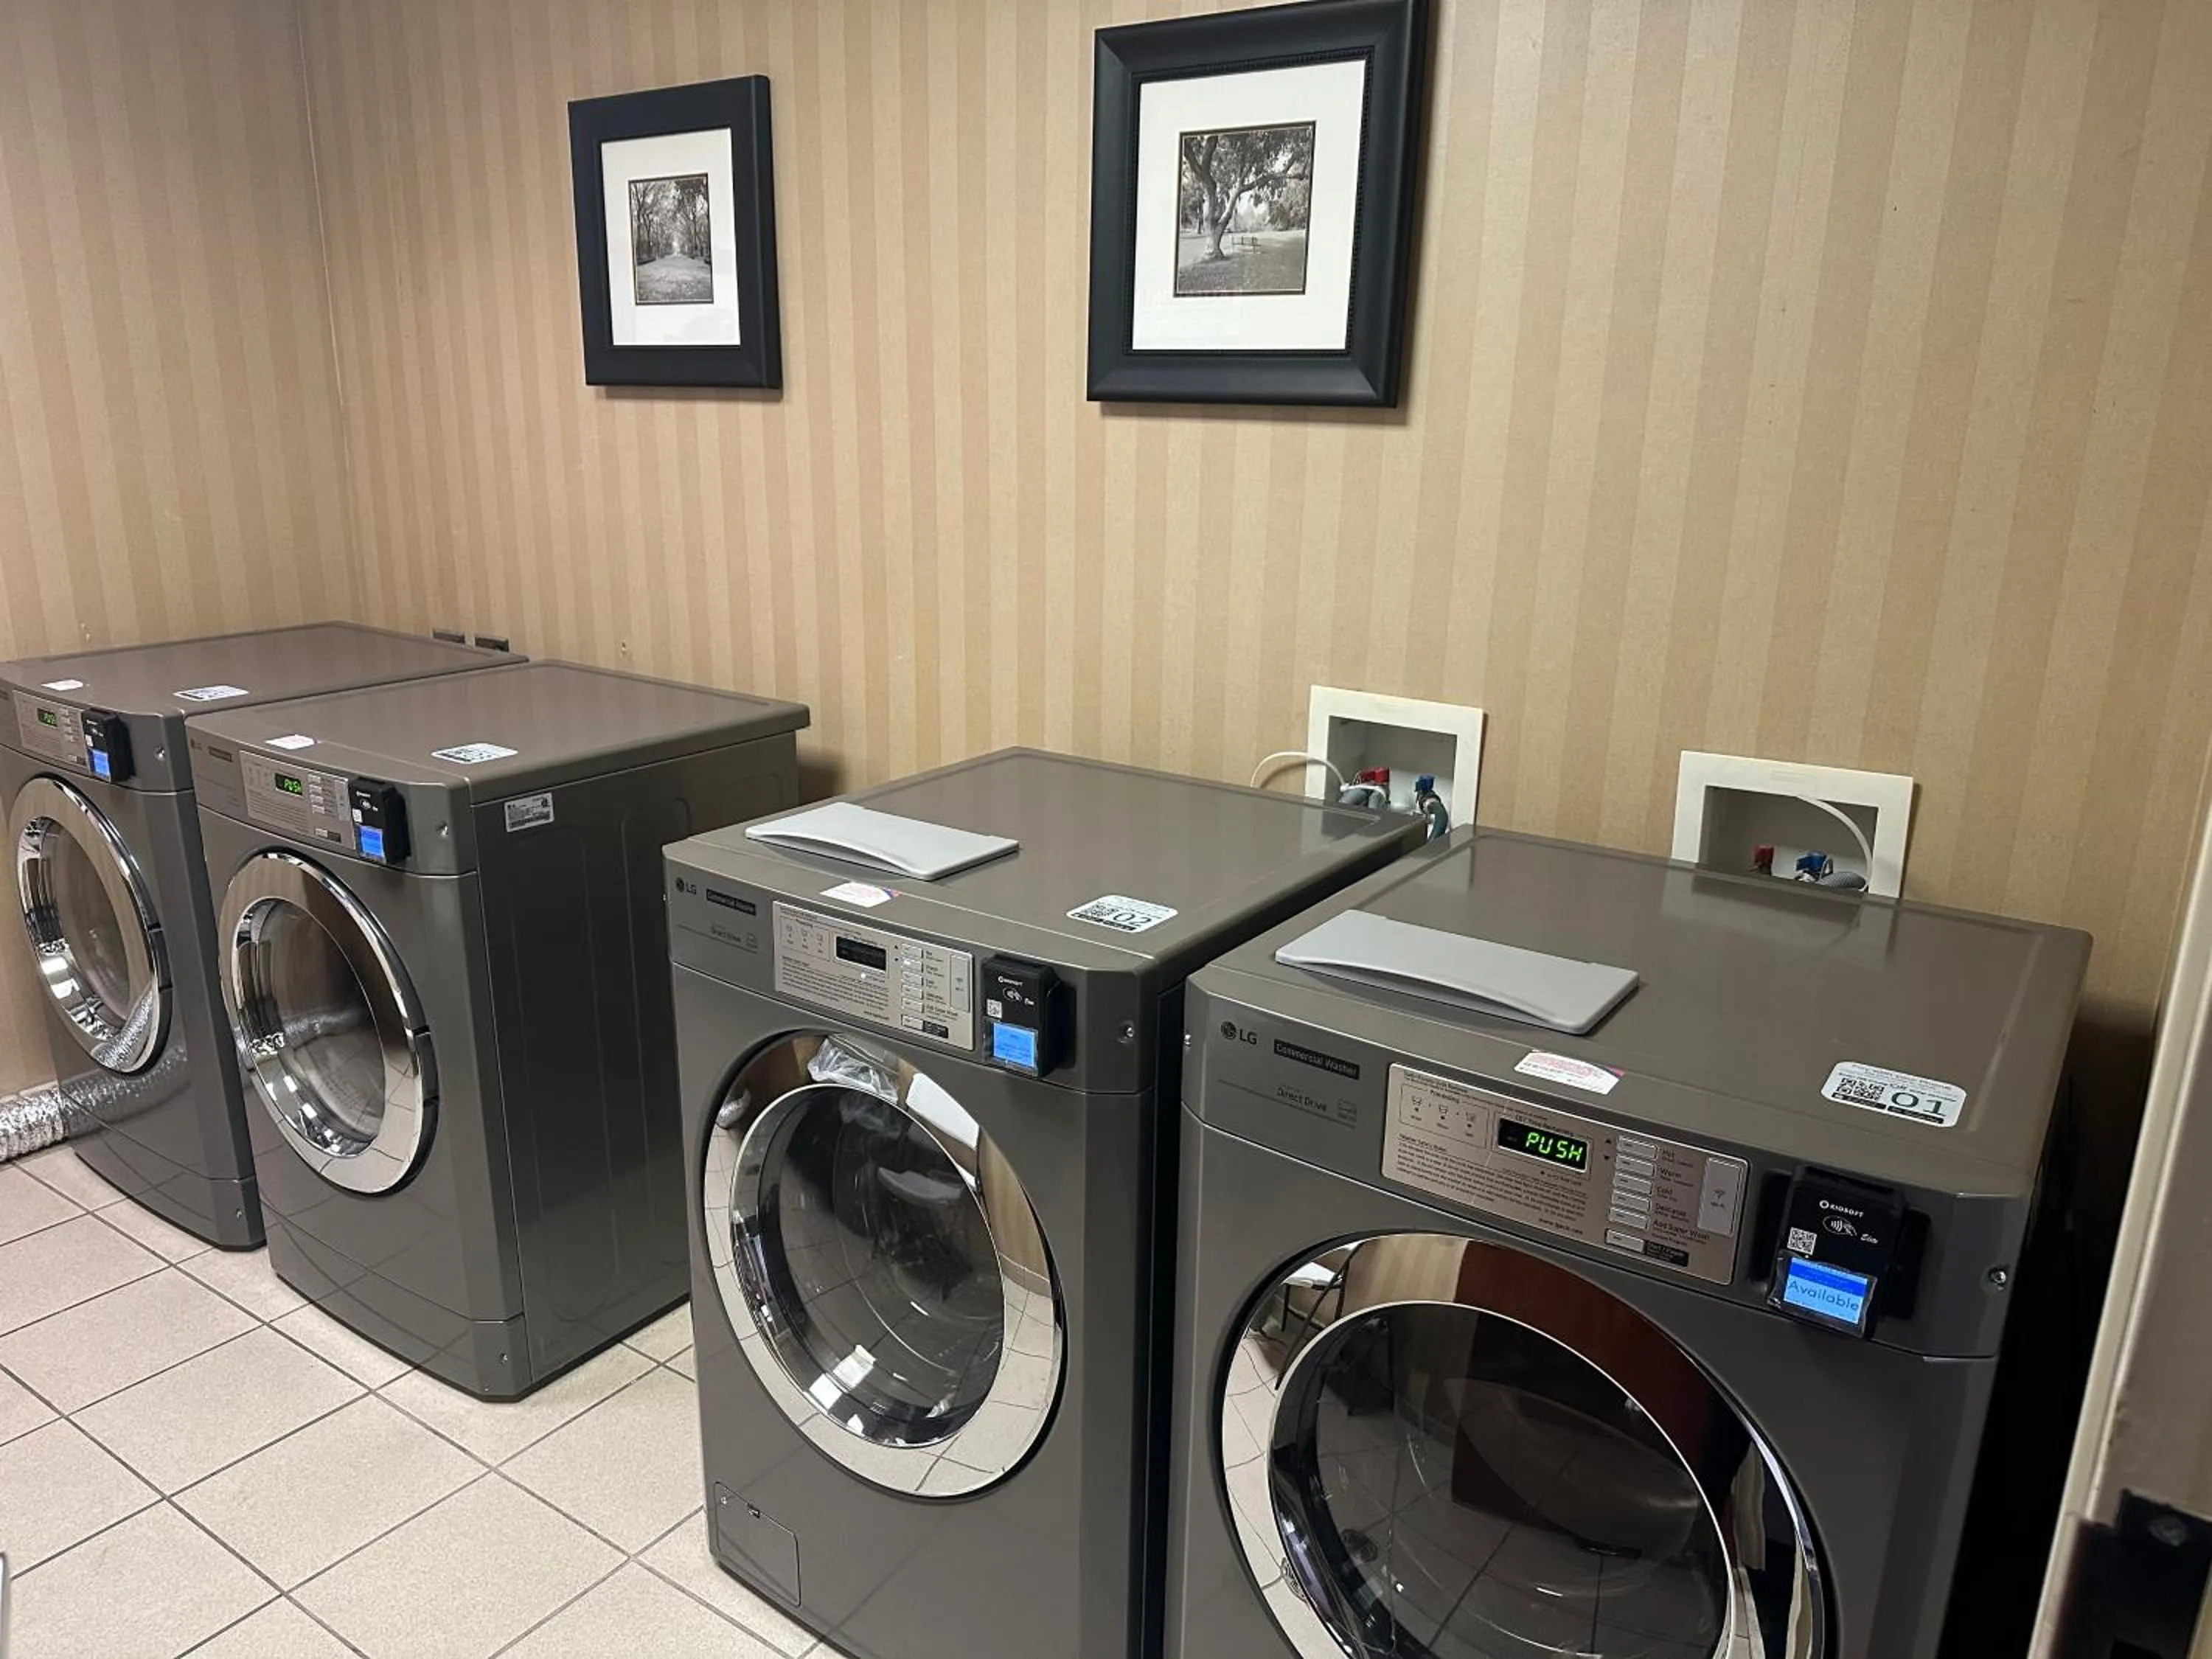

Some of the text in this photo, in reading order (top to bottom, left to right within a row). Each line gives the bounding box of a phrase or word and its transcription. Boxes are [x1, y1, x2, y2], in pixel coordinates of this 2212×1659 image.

[1113, 912, 1152, 928] 02
[1239, 1029, 1258, 1046] LG
[1891, 1092, 1947, 1117] 01
[1526, 1132, 1583, 1162] PUSH
[1788, 1280, 1860, 1310] Available
